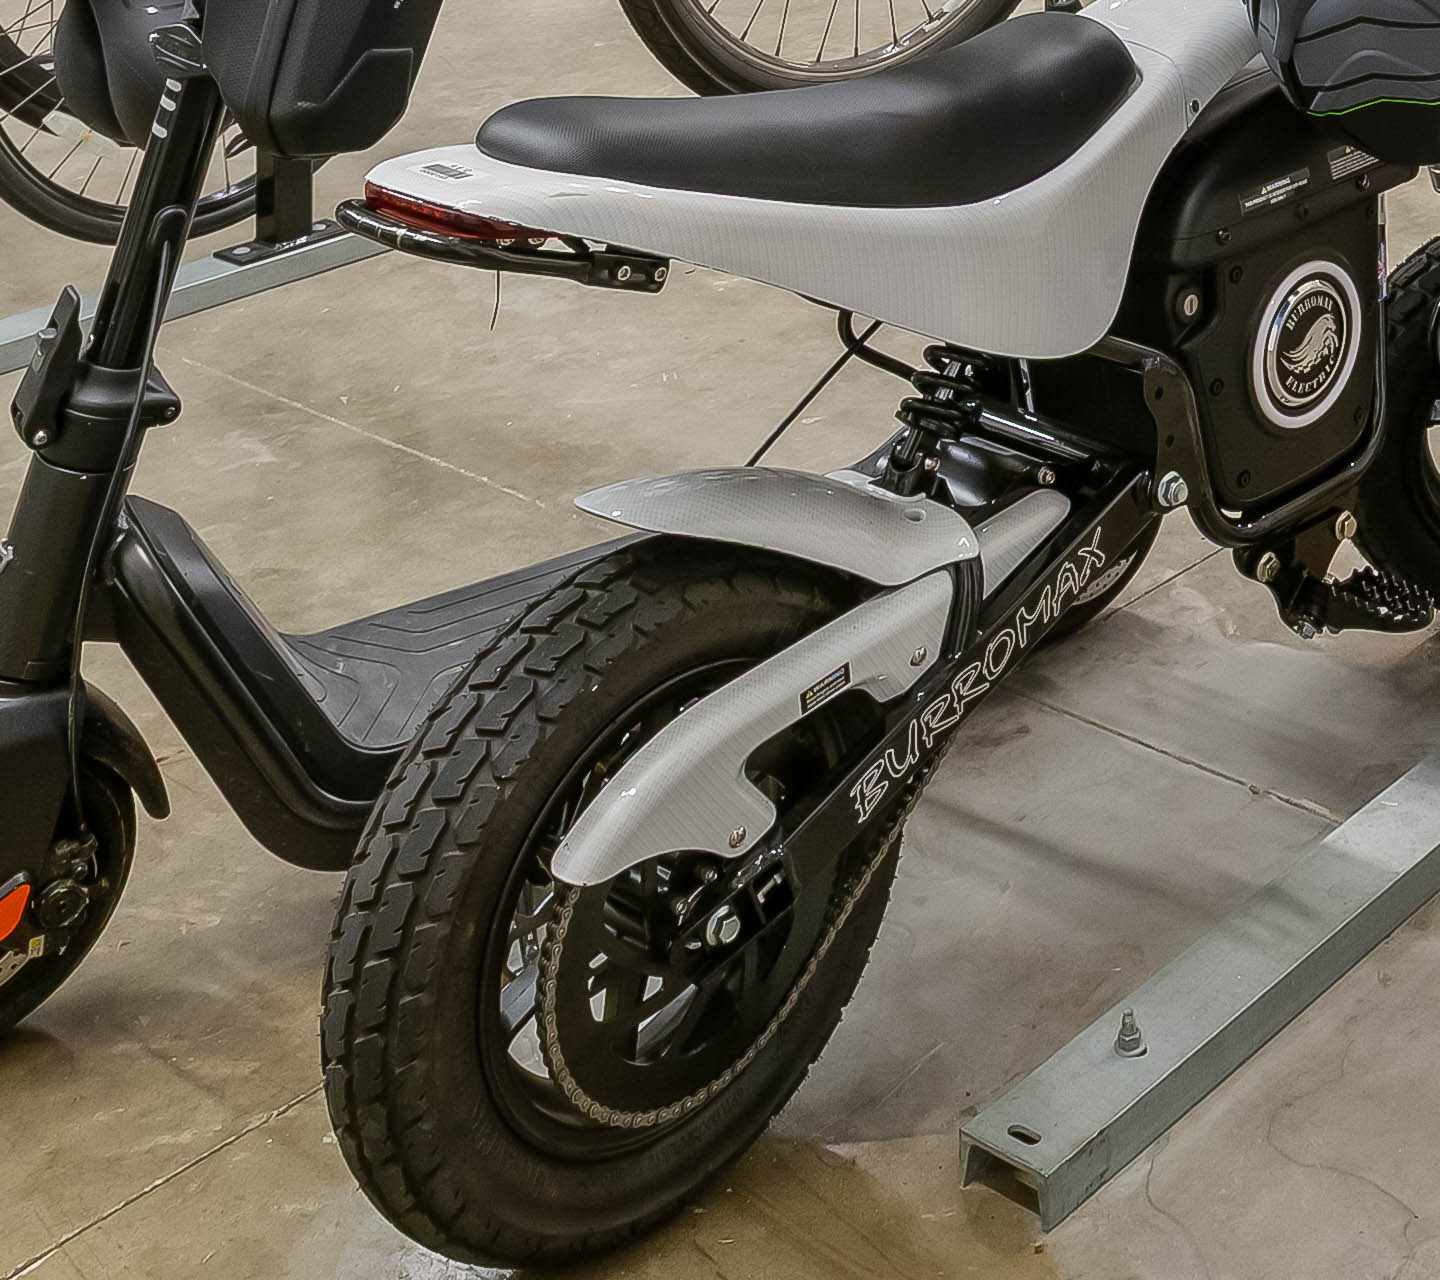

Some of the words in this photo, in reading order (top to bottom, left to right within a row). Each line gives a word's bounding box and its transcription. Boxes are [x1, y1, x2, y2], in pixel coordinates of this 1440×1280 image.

[1285, 294, 1334, 332] BURROMAX
[1285, 354, 1336, 394] ELECTRIC
[849, 525, 1111, 824] BURROMAX
